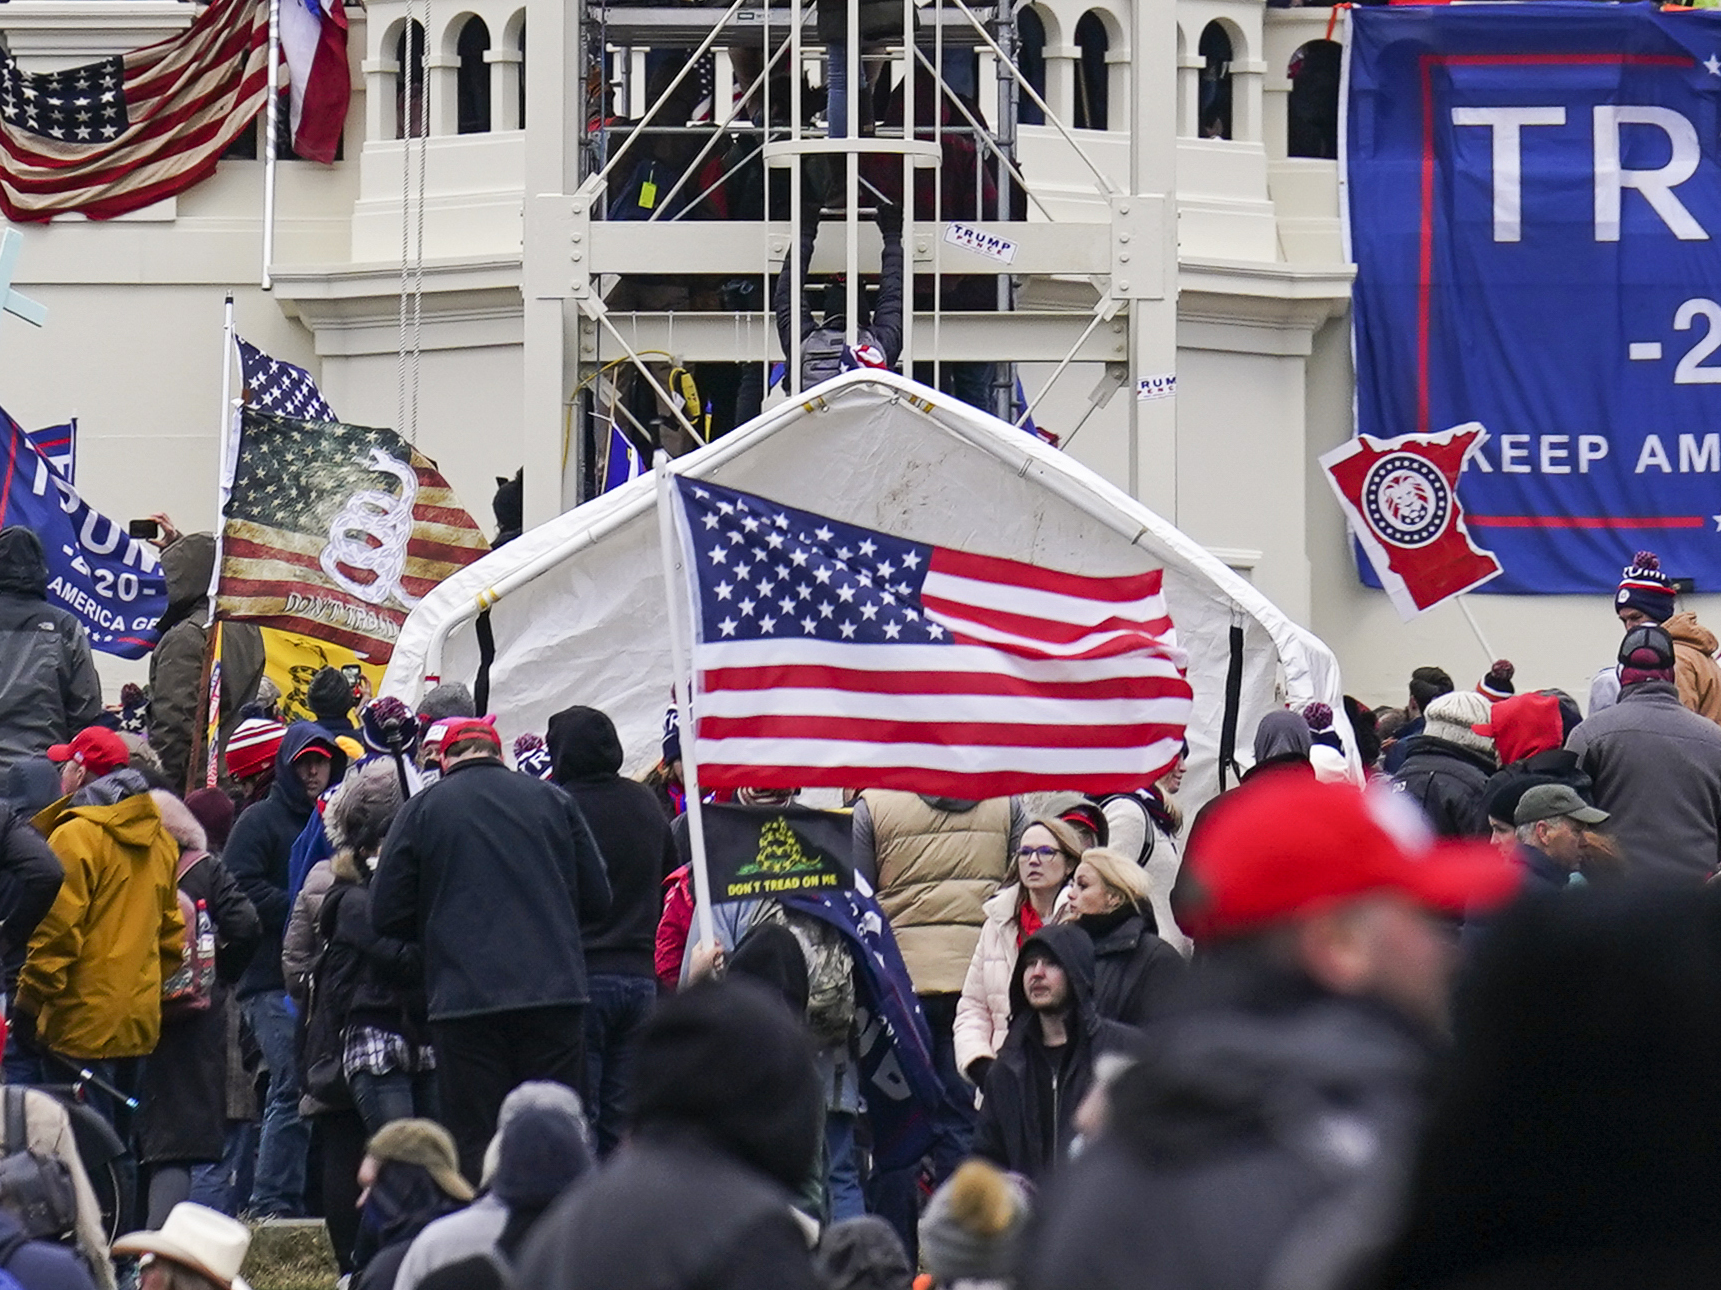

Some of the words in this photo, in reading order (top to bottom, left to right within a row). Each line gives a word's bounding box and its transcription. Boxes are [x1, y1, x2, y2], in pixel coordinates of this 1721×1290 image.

[954, 224, 1011, 250] TRUMP
[956, 234, 1002, 256] PENCE
[1463, 431, 1609, 474] KEEP
[47, 576, 126, 632] AMERICA
[727, 881, 761, 896] DON'T
[763, 877, 800, 892] TREAD
[802, 875, 819, 888] ON
[822, 874, 837, 886] ME
